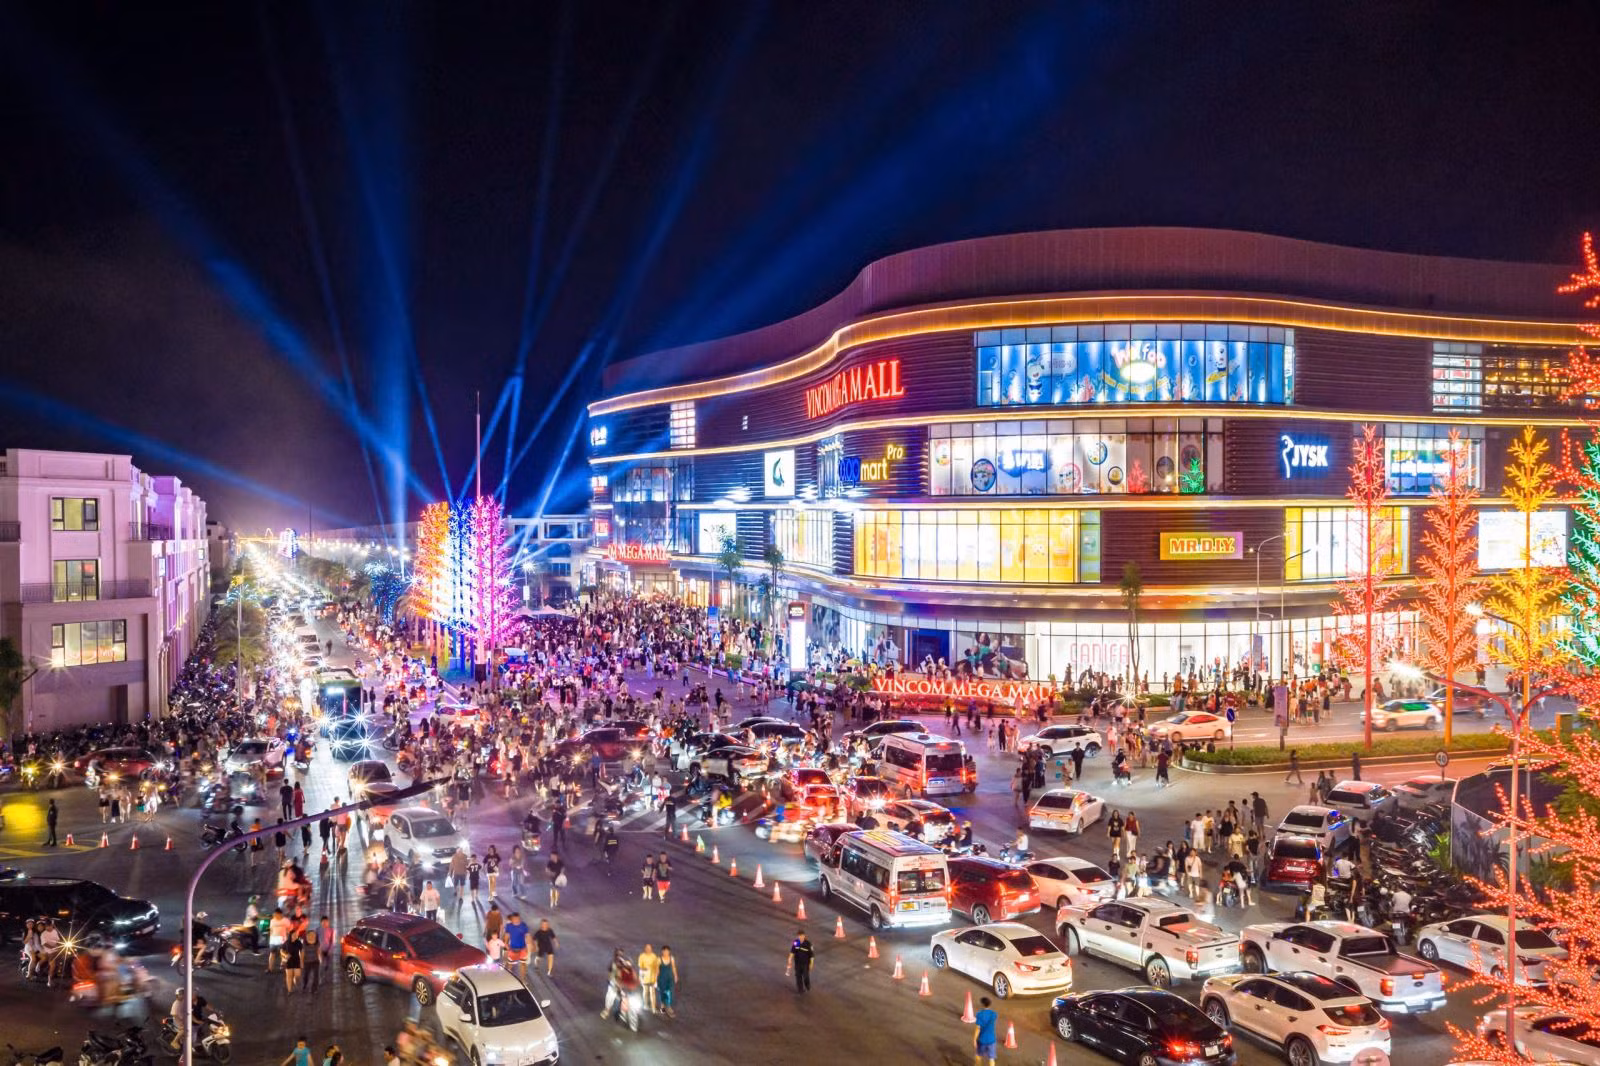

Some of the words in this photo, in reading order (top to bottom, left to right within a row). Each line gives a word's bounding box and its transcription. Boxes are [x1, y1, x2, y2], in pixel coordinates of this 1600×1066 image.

[849, 359, 905, 403] MALL
[887, 444, 903, 460] Pro
[1291, 444, 1328, 467] JYSK
[1070, 643, 1129, 663] CANIFA
[875, 679, 946, 694] VINCOM
[950, 682, 1003, 698] MEGA
[470, 864, 479, 872] 77
